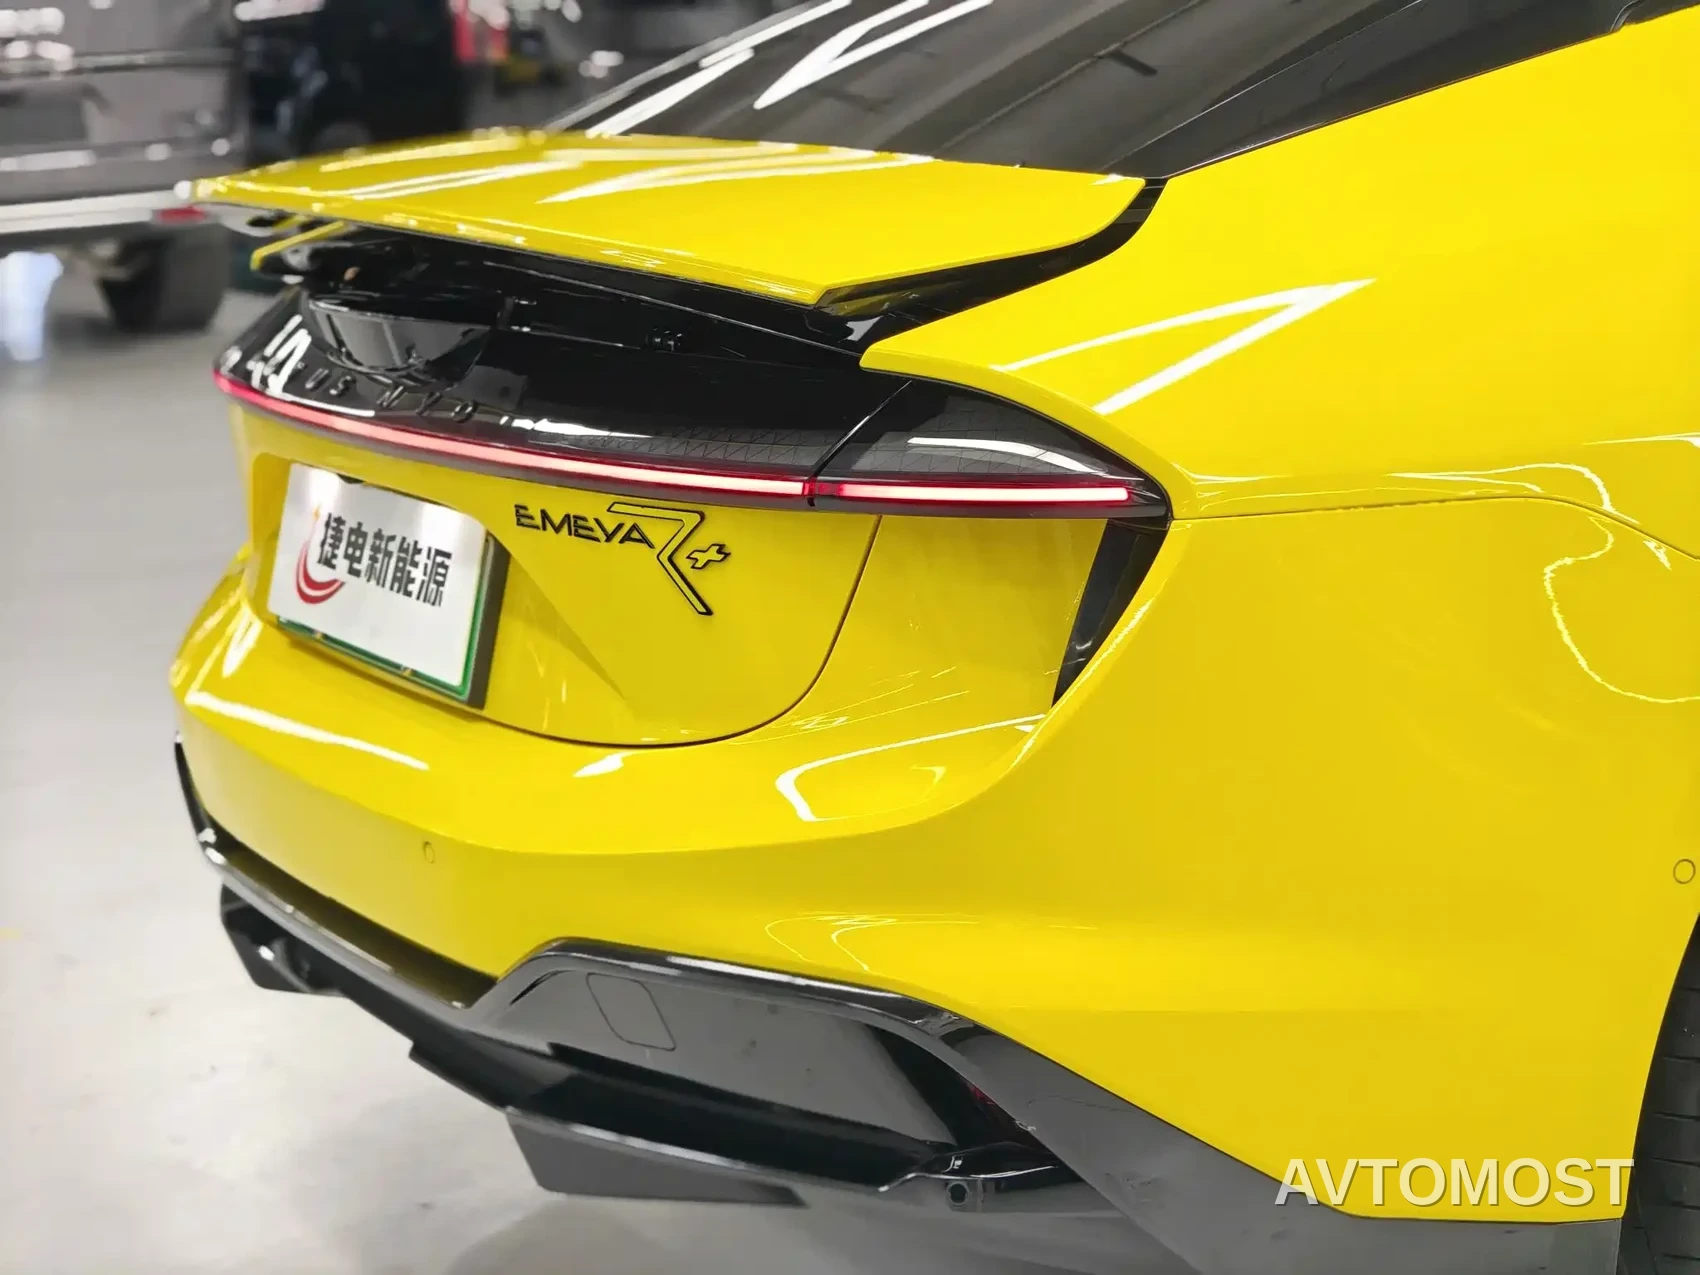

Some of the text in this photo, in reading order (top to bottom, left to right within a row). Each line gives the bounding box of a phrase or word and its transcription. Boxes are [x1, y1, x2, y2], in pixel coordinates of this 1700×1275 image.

[317, 512, 453, 608] 捷电新能源
[514, 504, 655, 549] EMEYA
